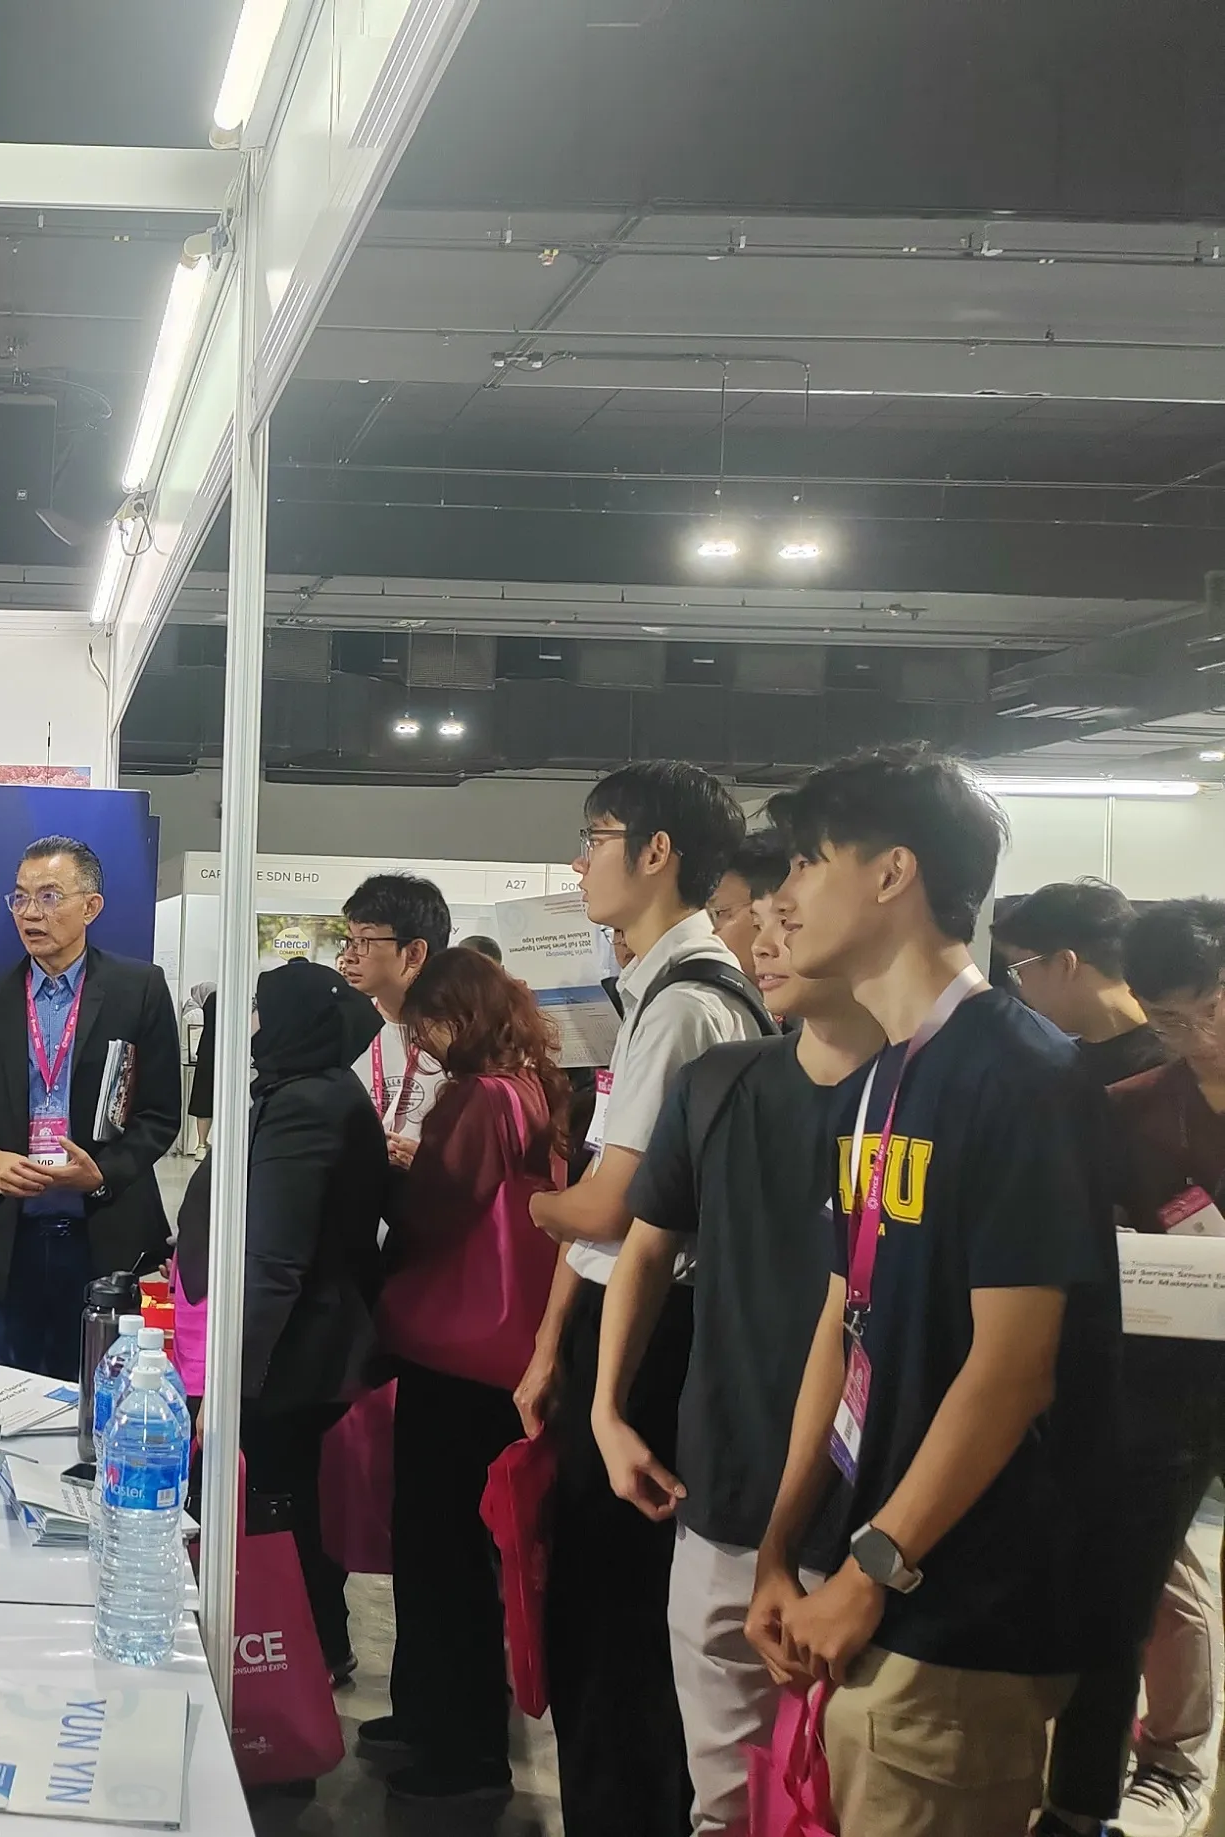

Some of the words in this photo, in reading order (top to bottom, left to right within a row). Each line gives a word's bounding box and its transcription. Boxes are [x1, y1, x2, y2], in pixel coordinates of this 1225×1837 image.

[266, 871, 291, 882] SDN
[294, 872, 320, 883] BHD
[505, 880, 527, 890] A27
[274, 938, 311, 949] Enercal
[268, 1662, 288, 1672] EXPO
[57, 1699, 107, 1751] YUN
[46, 1760, 97, 1804] YIN
